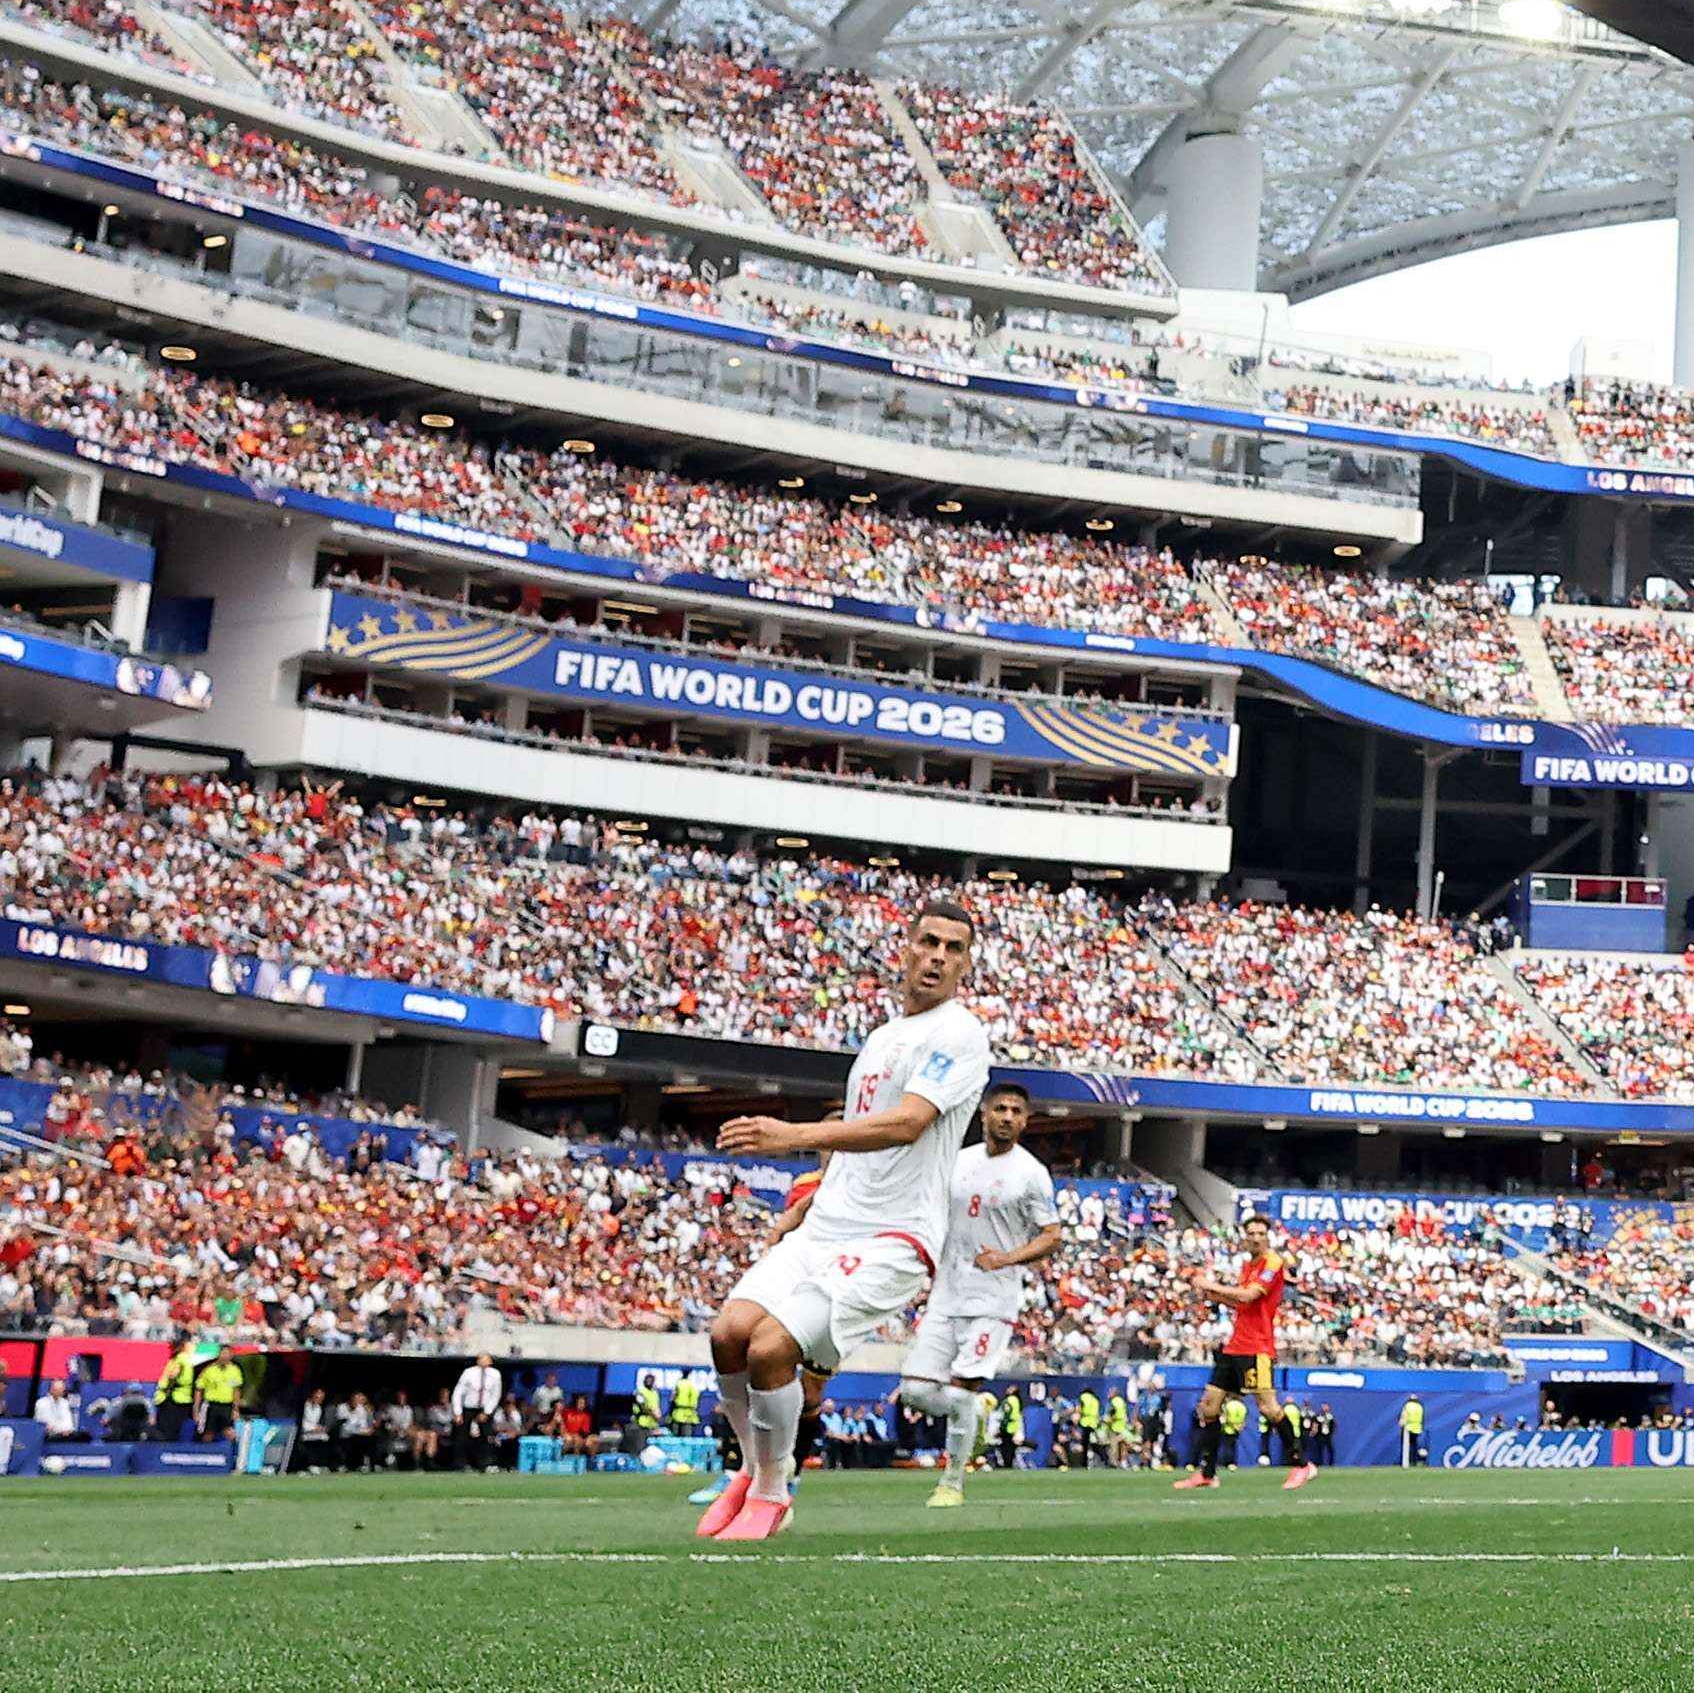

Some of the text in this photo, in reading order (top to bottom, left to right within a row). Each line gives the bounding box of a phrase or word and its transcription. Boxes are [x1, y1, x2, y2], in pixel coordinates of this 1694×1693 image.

[554, 649, 1006, 744] FIFA WORLD CUP 2026
[1534, 757, 1591, 781] FIFA
[1594, 759, 1689, 786] WORLD
[1310, 1092, 1353, 1113] FIFA
[1354, 1093, 1425, 1116] WORLD
[1426, 1097, 1465, 1117] CUP
[968, 1193, 981, 1217] 8
[1281, 1195, 1340, 1221] FIFA
[975, 1333, 989, 1356] 8
[1443, 1428, 1601, 1469] Michelob
